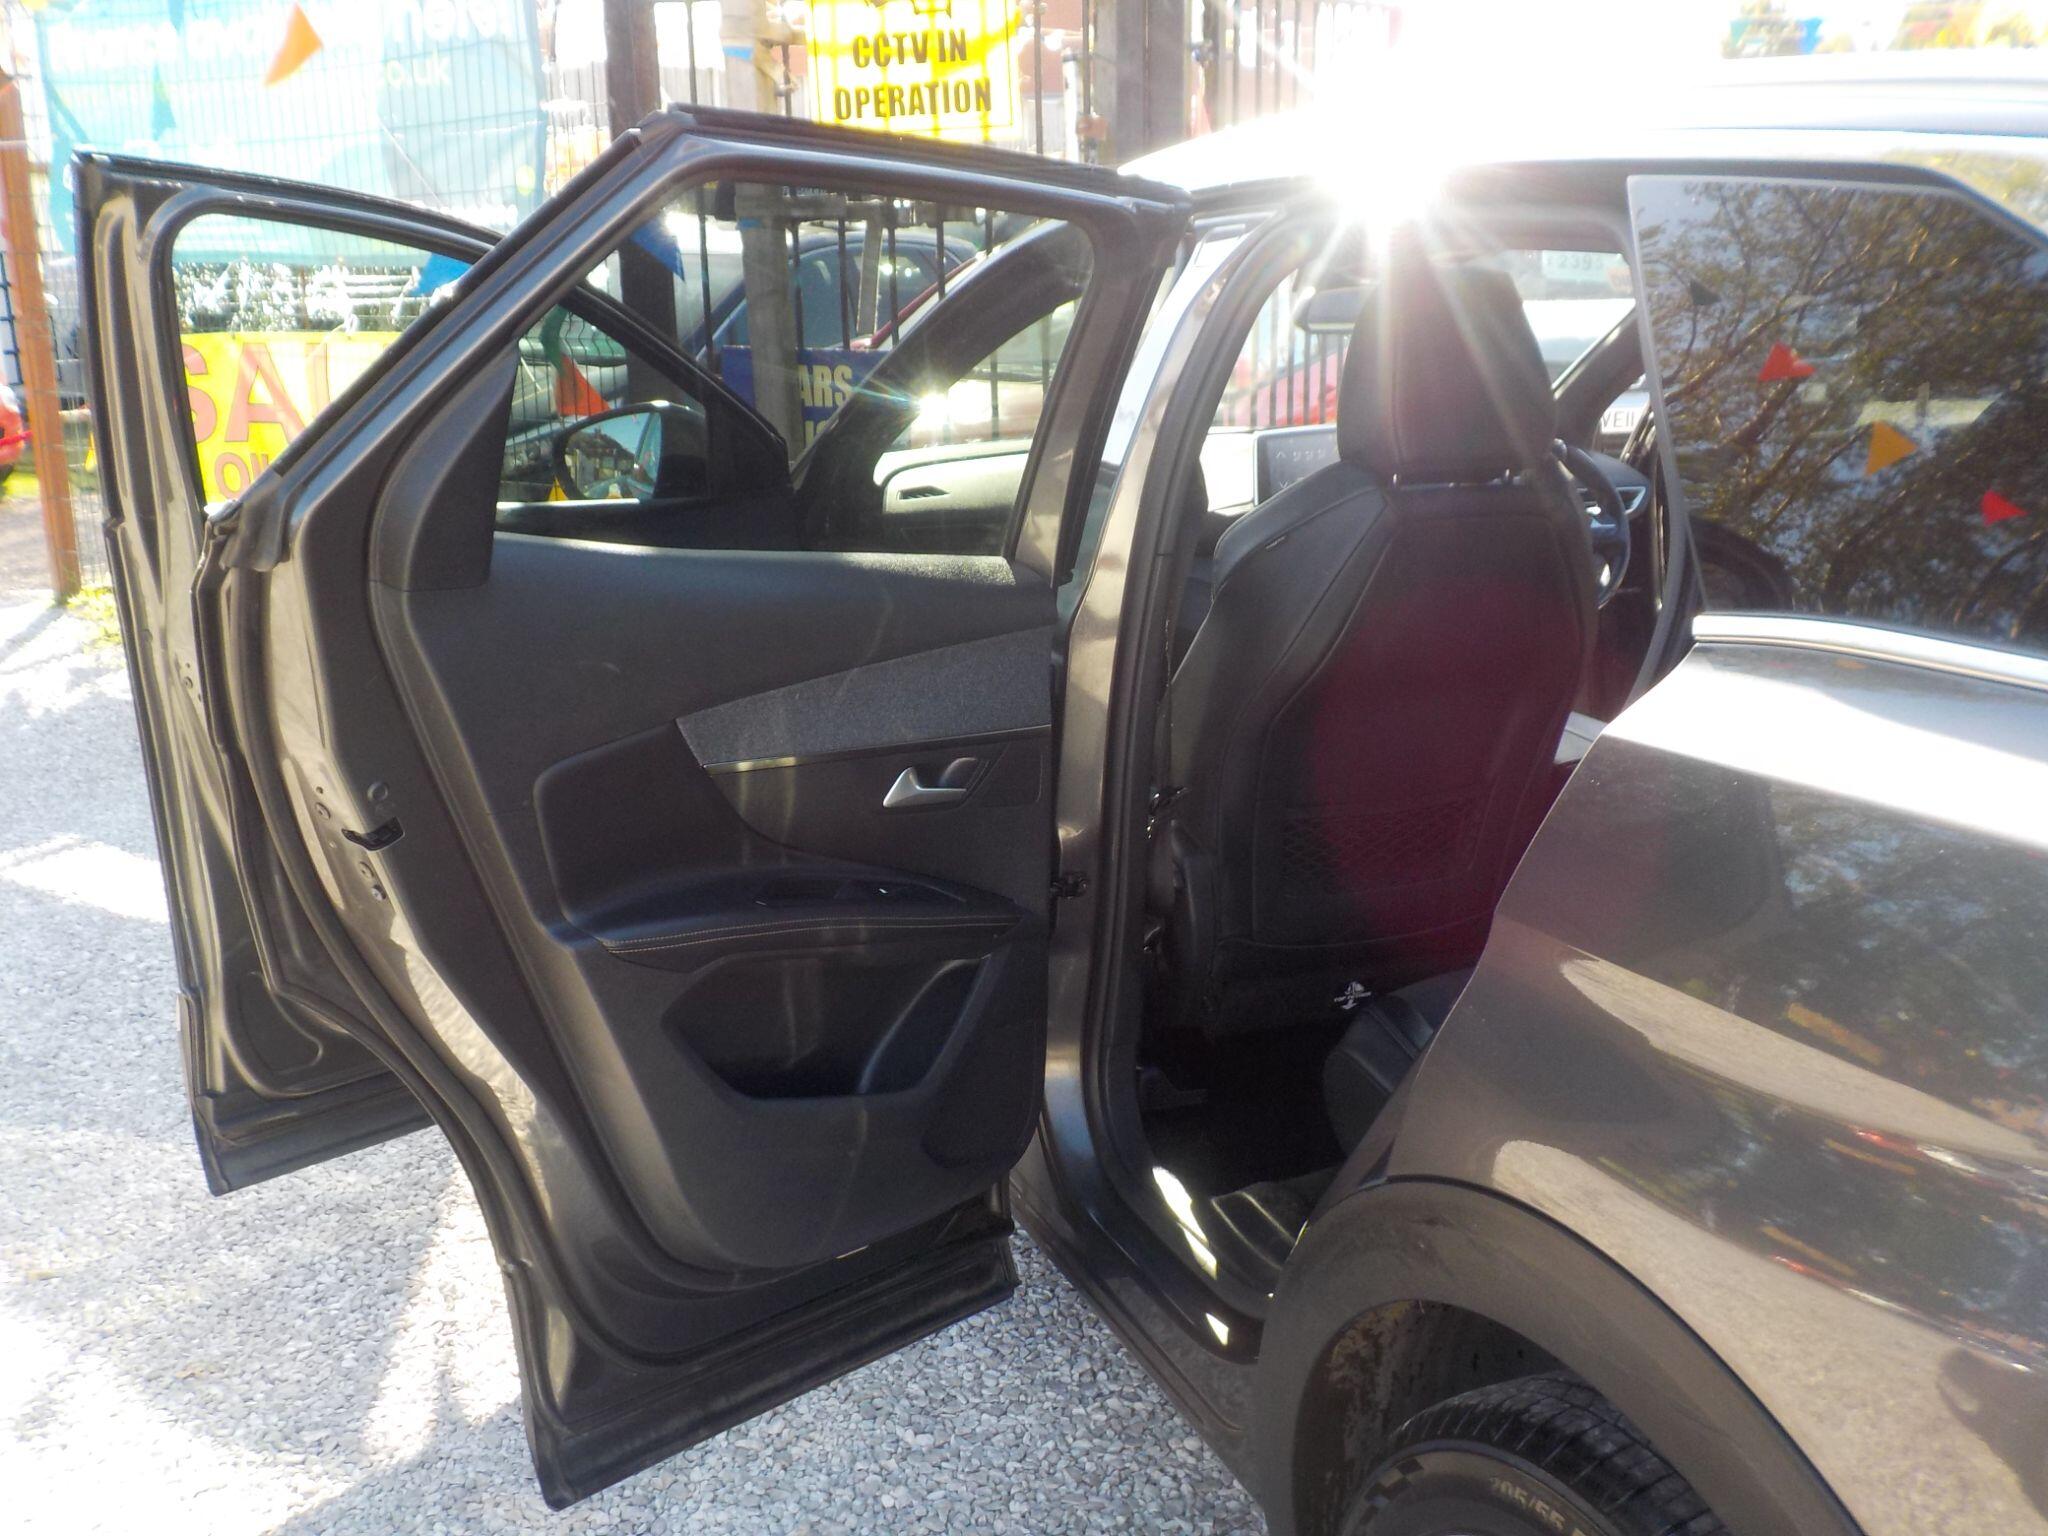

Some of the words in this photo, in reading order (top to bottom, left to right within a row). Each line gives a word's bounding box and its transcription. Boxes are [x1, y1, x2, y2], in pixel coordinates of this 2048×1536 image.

[853, 31, 928, 68] CCTV
[938, 28, 967, 62] IN
[834, 77, 991, 120] OPERATION
[799, 364, 852, 408] ARS
